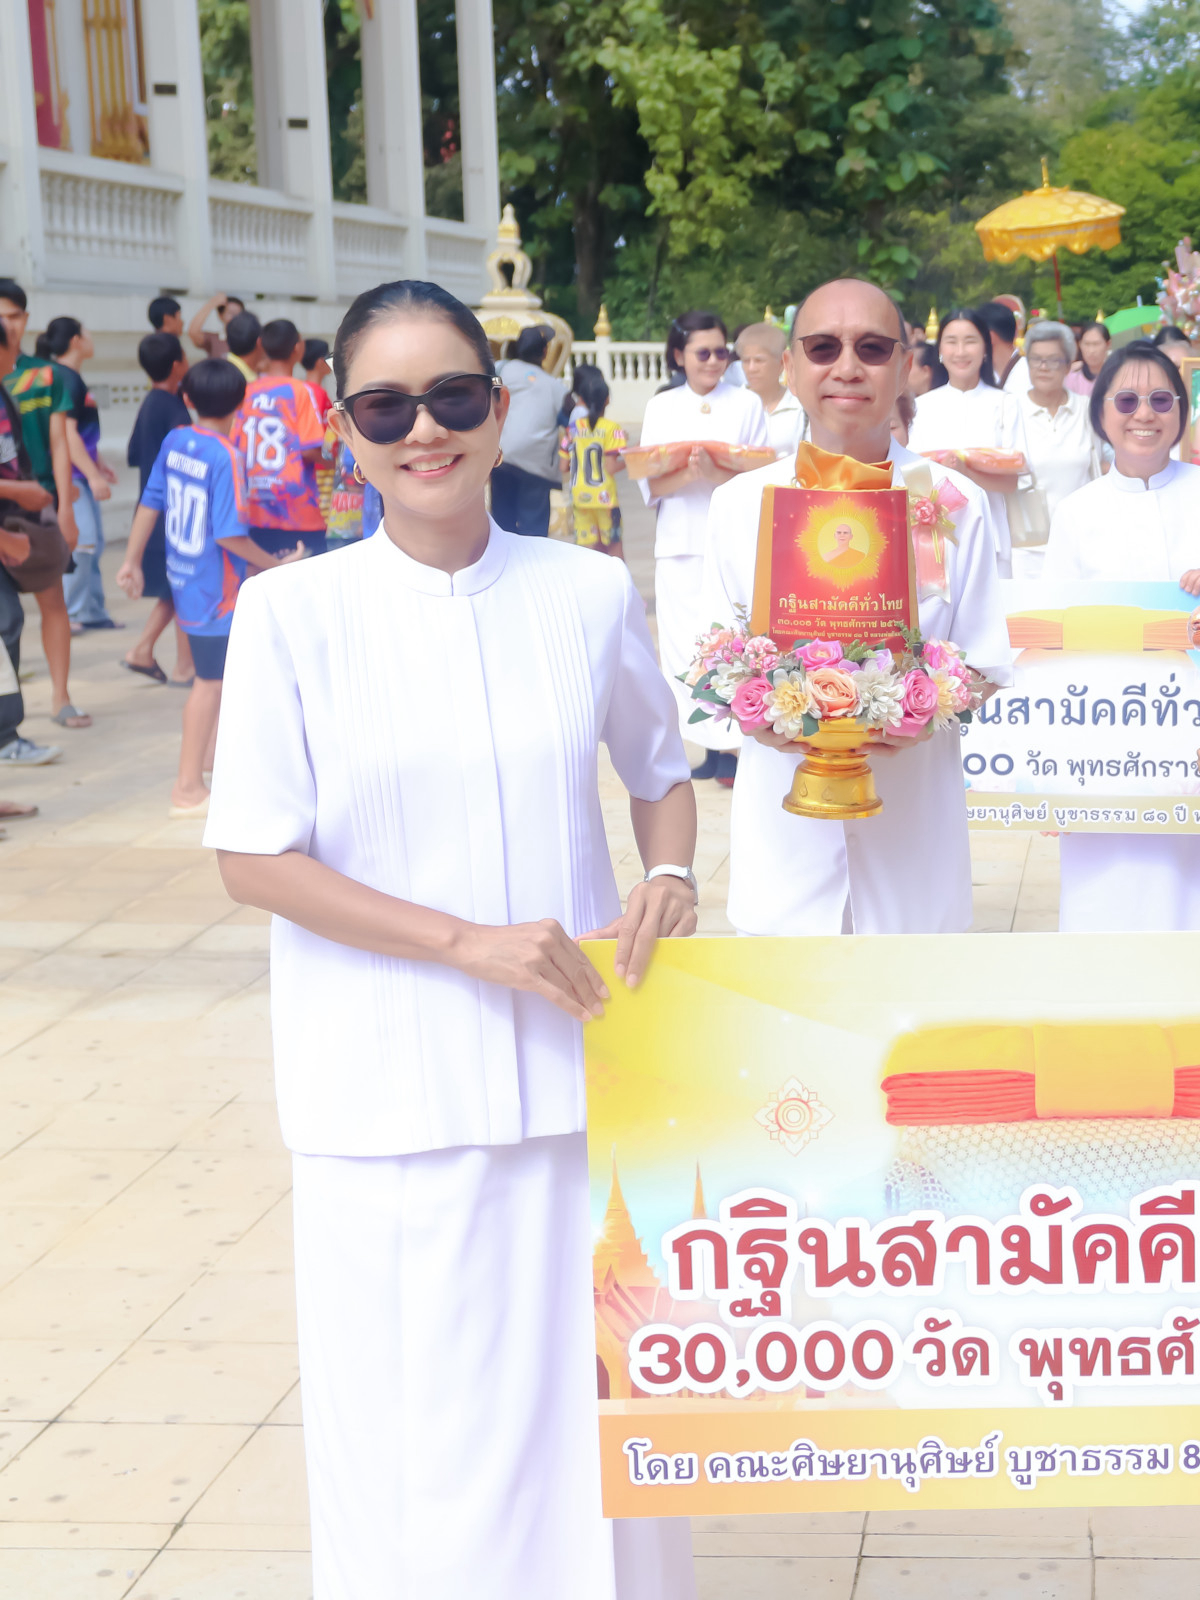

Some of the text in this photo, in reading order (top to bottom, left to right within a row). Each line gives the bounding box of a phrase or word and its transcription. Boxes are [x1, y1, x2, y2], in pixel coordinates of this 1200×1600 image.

[243, 415, 287, 471] 18
[165, 473, 208, 558] 80
[778, 592, 903, 614] กฐินสามัคคีทั่วไทย
[829, 618, 877, 631] พุทธศักราช
[1026, 750, 1058, 776] วัด
[1054, 807, 1136, 826] บูชาธรรม
[1143, 810, 1168, 823] ๘๑
[1175, 805, 1187, 823] ปี
[638, 1329, 894, 1388] 30,000
[912, 1317, 990, 1377] วัด
[627, 1442, 695, 1481] โดย
[708, 1434, 998, 1488] คณะศิษยานุศิษย์
[1007, 1445, 1171, 1486] บูชาธรรม
